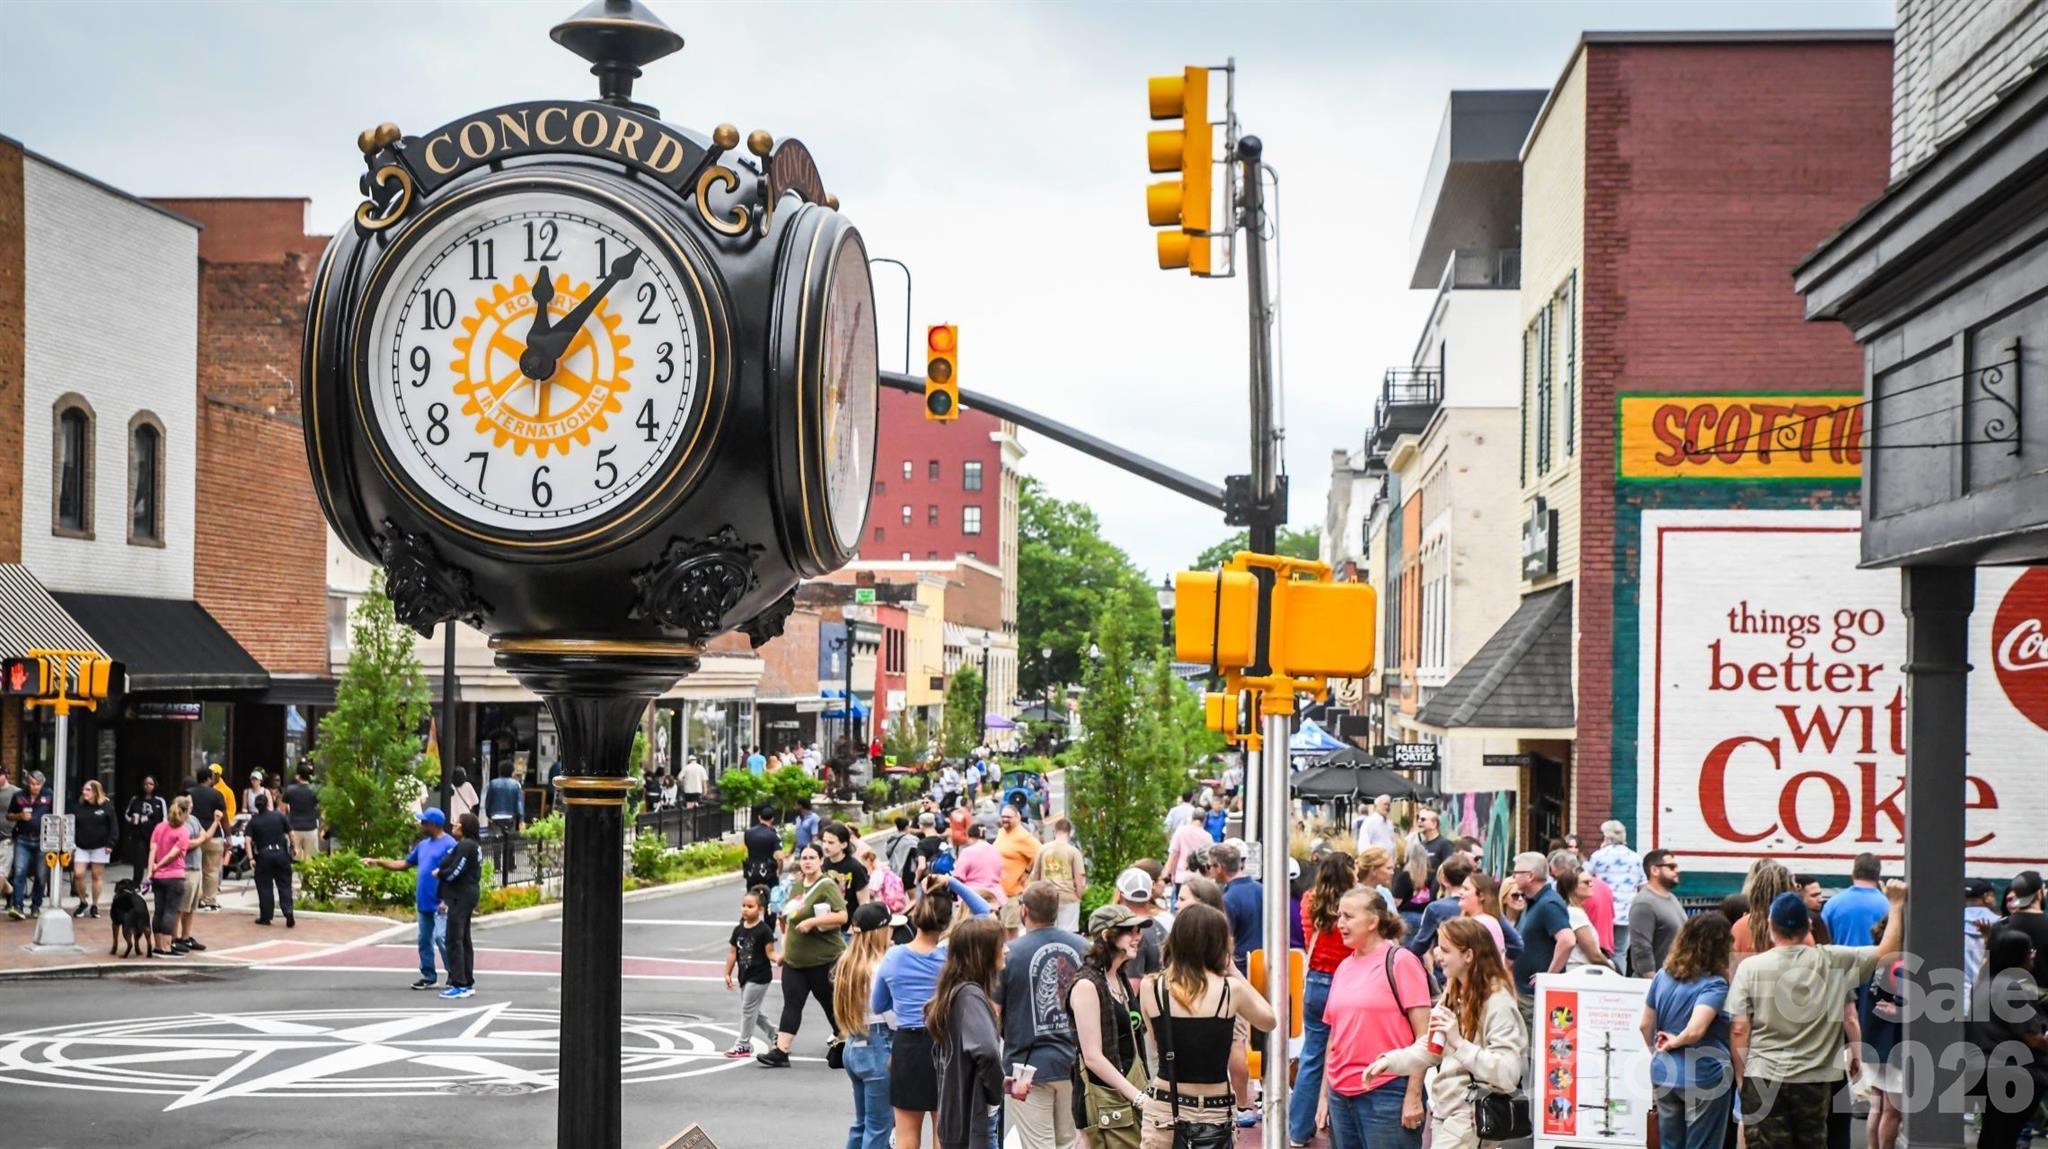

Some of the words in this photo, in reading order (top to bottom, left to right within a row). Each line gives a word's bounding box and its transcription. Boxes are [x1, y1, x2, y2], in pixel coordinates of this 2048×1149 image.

[425, 107, 684, 174] CONCORD
[468, 238, 498, 281] 11
[523, 220, 561, 262] 12
[420, 288, 456, 330] 10
[637, 282, 661, 325] 2
[409, 345, 431, 388] 9
[655, 341, 675, 384] 3
[426, 402, 450, 446] 8
[636, 398, 661, 442] 4
[465, 451, 489, 495] 7
[531, 465, 553, 508] 6
[594, 444, 619, 490] 5
[1727, 600, 1820, 649] things
[1831, 608, 1885, 653] go
[1707, 638, 1884, 693] better
[1775, 684, 1971, 756] wit
[1395, 753, 1436, 762] PORTER
